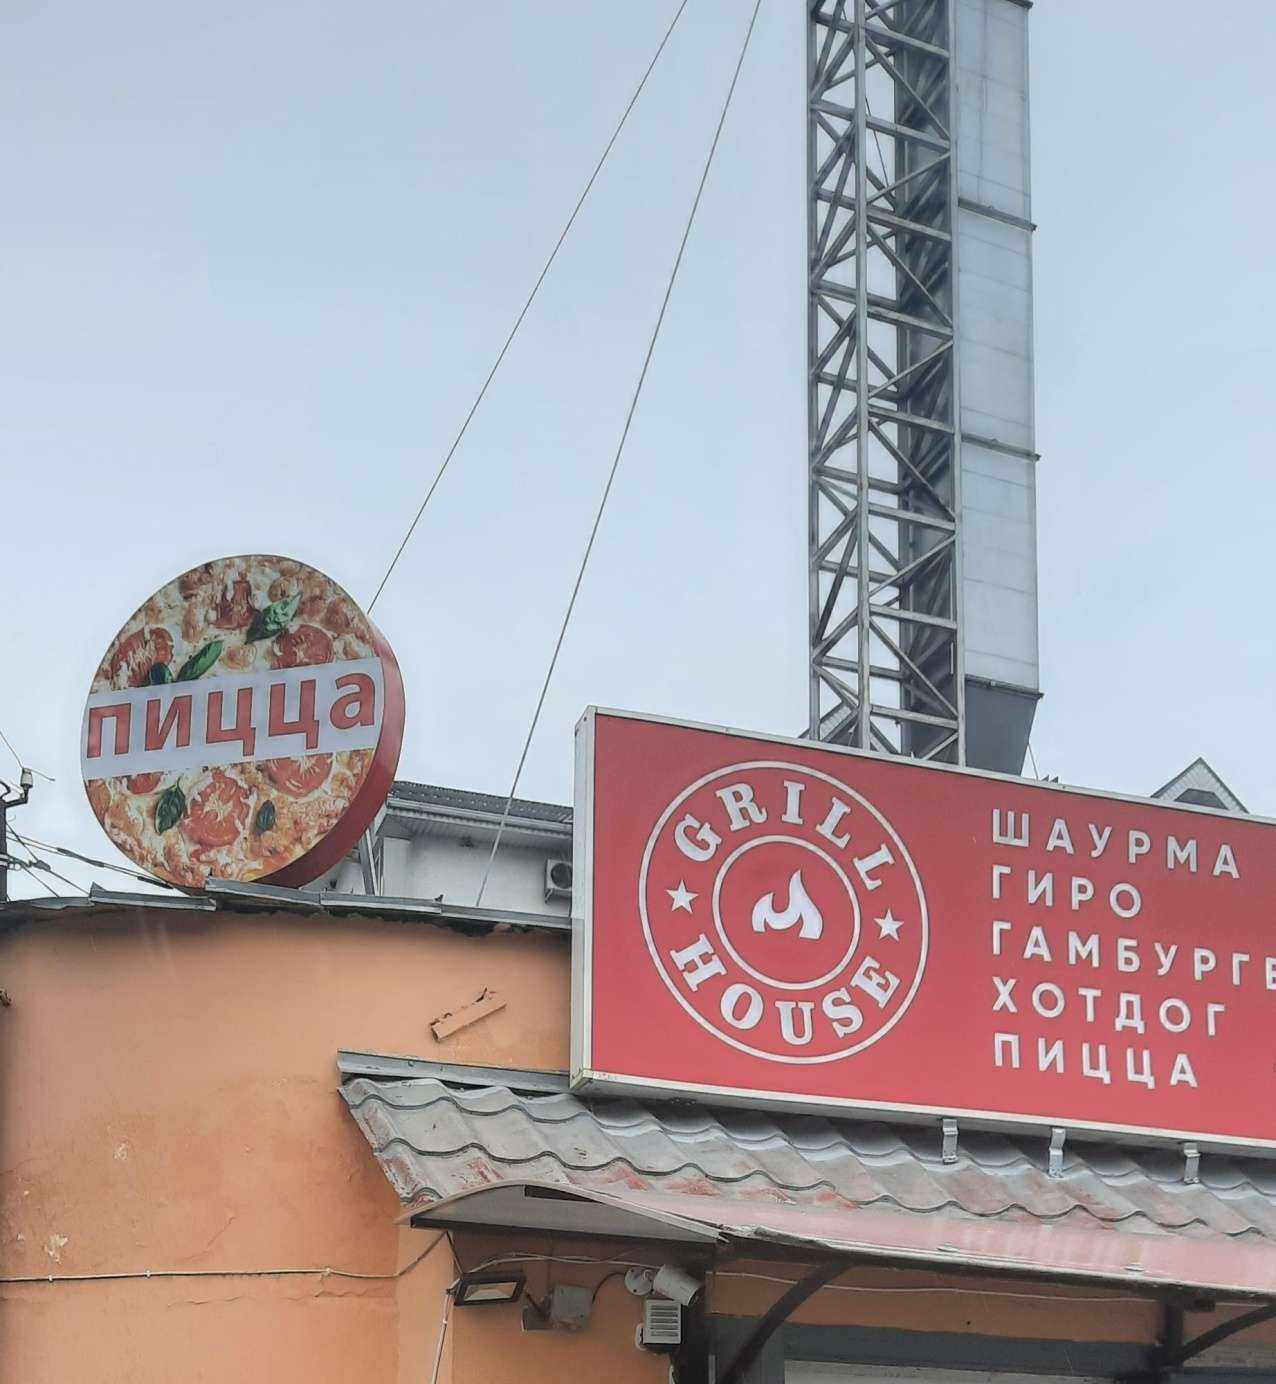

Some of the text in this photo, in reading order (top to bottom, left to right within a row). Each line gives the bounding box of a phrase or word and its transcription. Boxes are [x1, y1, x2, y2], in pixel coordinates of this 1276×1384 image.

[86, 671, 376, 757] пицца
[673, 779, 895, 891] GRILL
[991, 808, 1241, 880] ШАУРМА
[992, 864, 1143, 919] ГИРО
[669, 934, 901, 1046] HOUSE
[992, 975, 1226, 1037] ХОТДОГ
[993, 1031, 1199, 1089] ПИЦЦА
